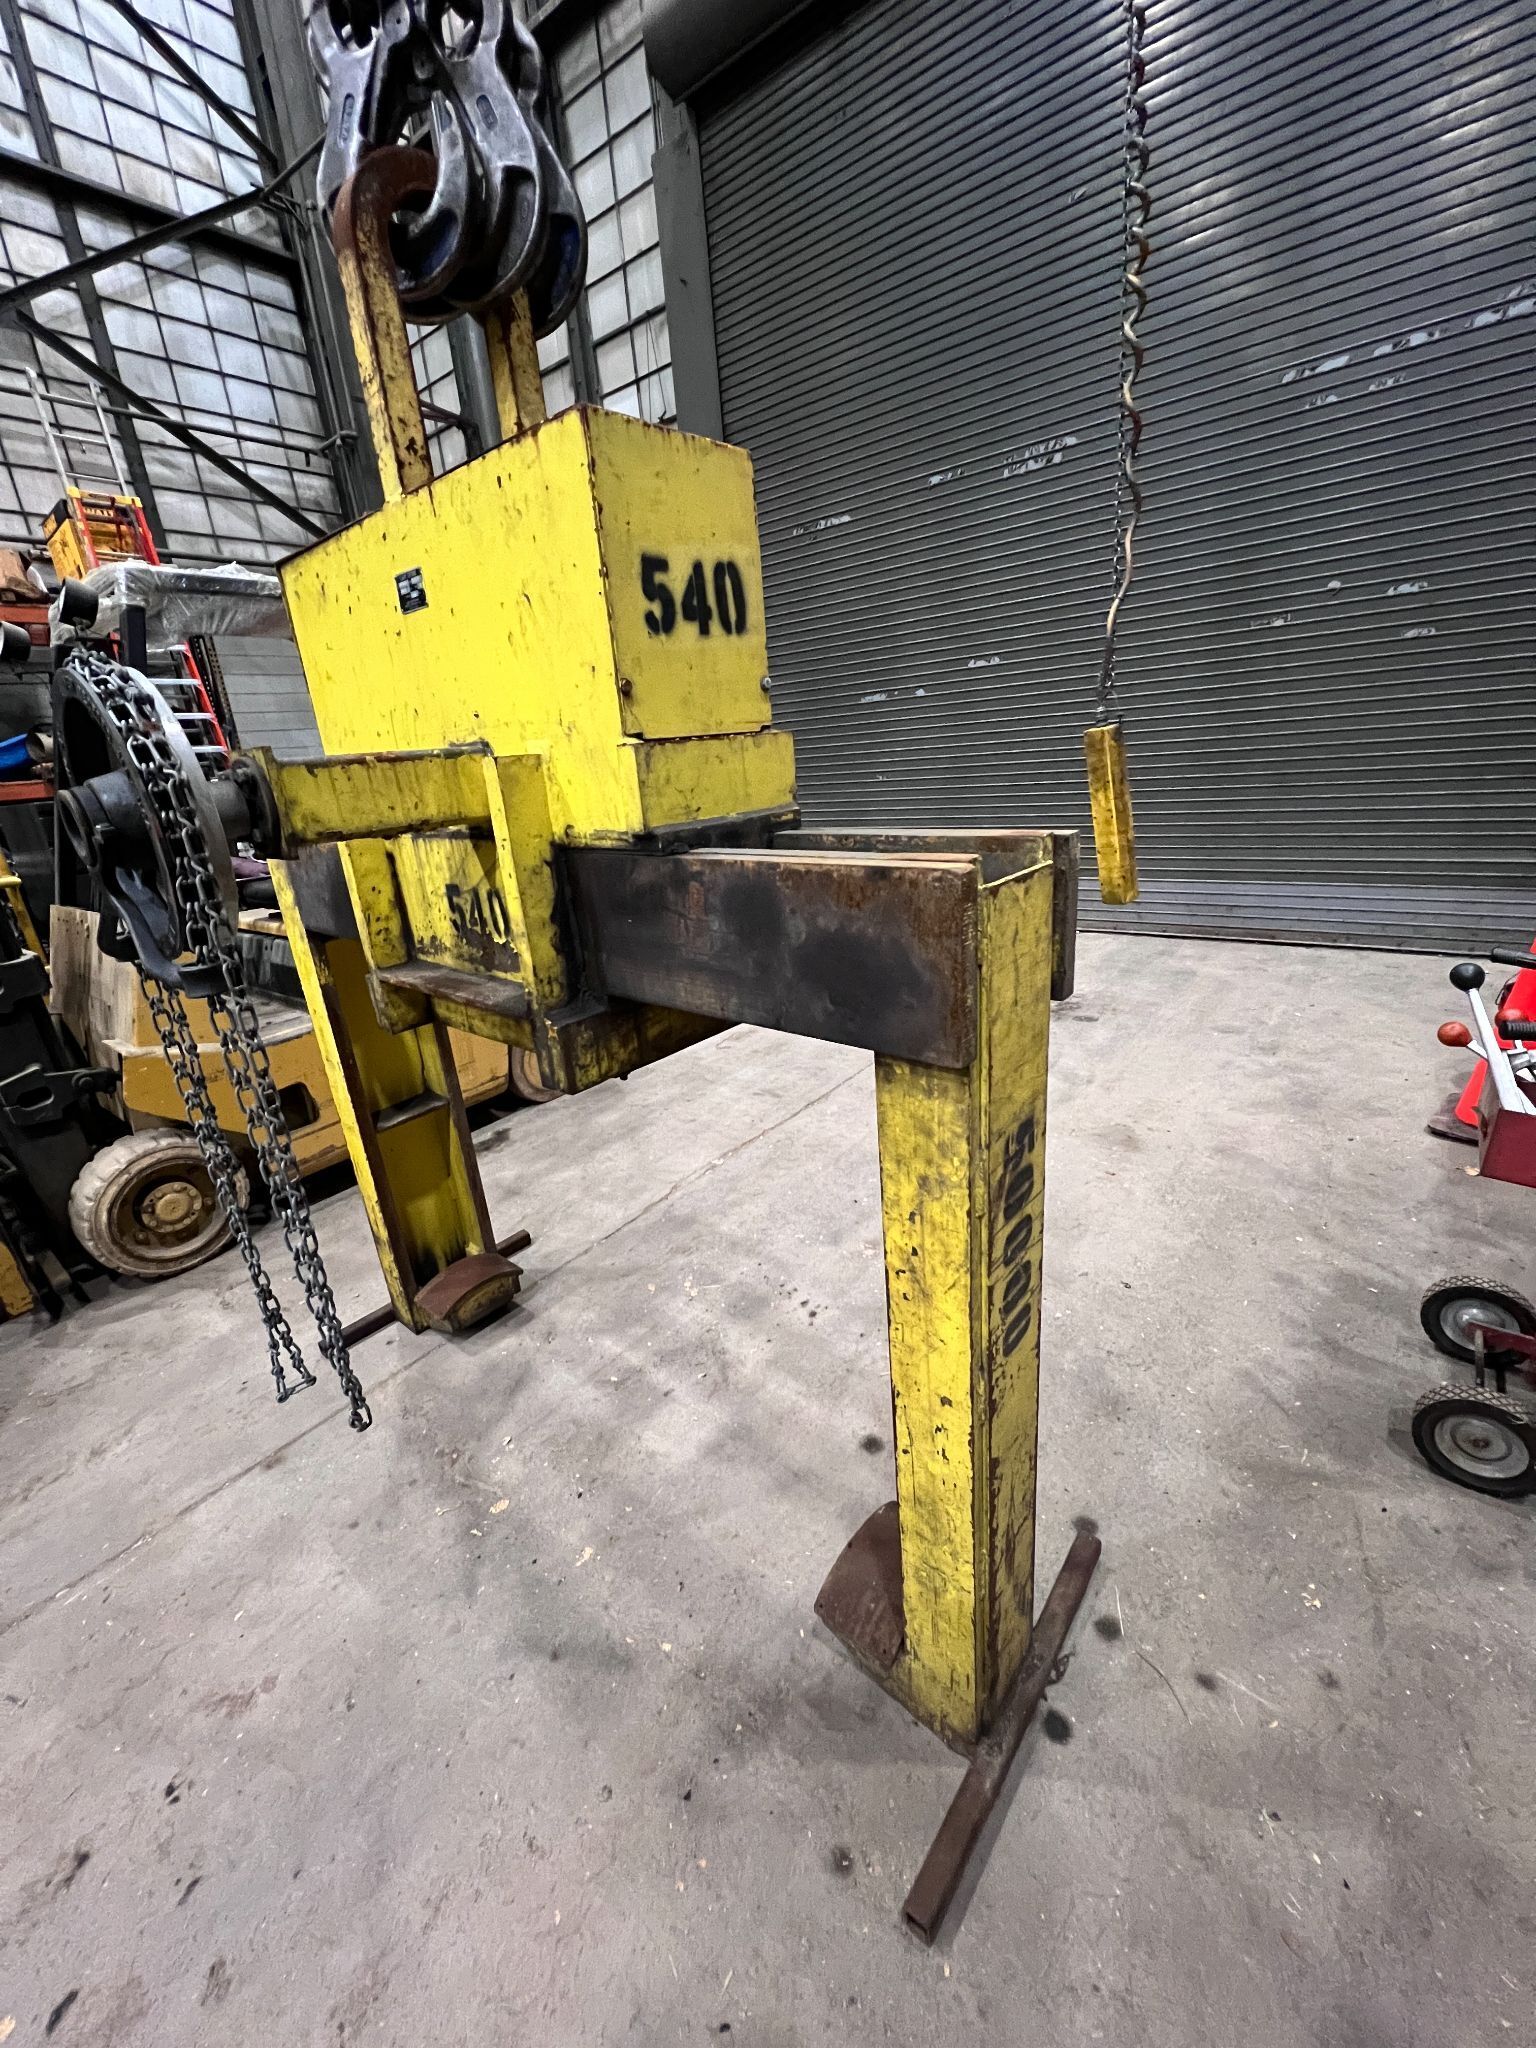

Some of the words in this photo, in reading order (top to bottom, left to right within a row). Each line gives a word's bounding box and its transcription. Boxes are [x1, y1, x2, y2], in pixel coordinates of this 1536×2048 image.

[641, 552, 747, 636] 540
[445, 883, 511, 939] 540
[1003, 1115, 1035, 1357] 50000
